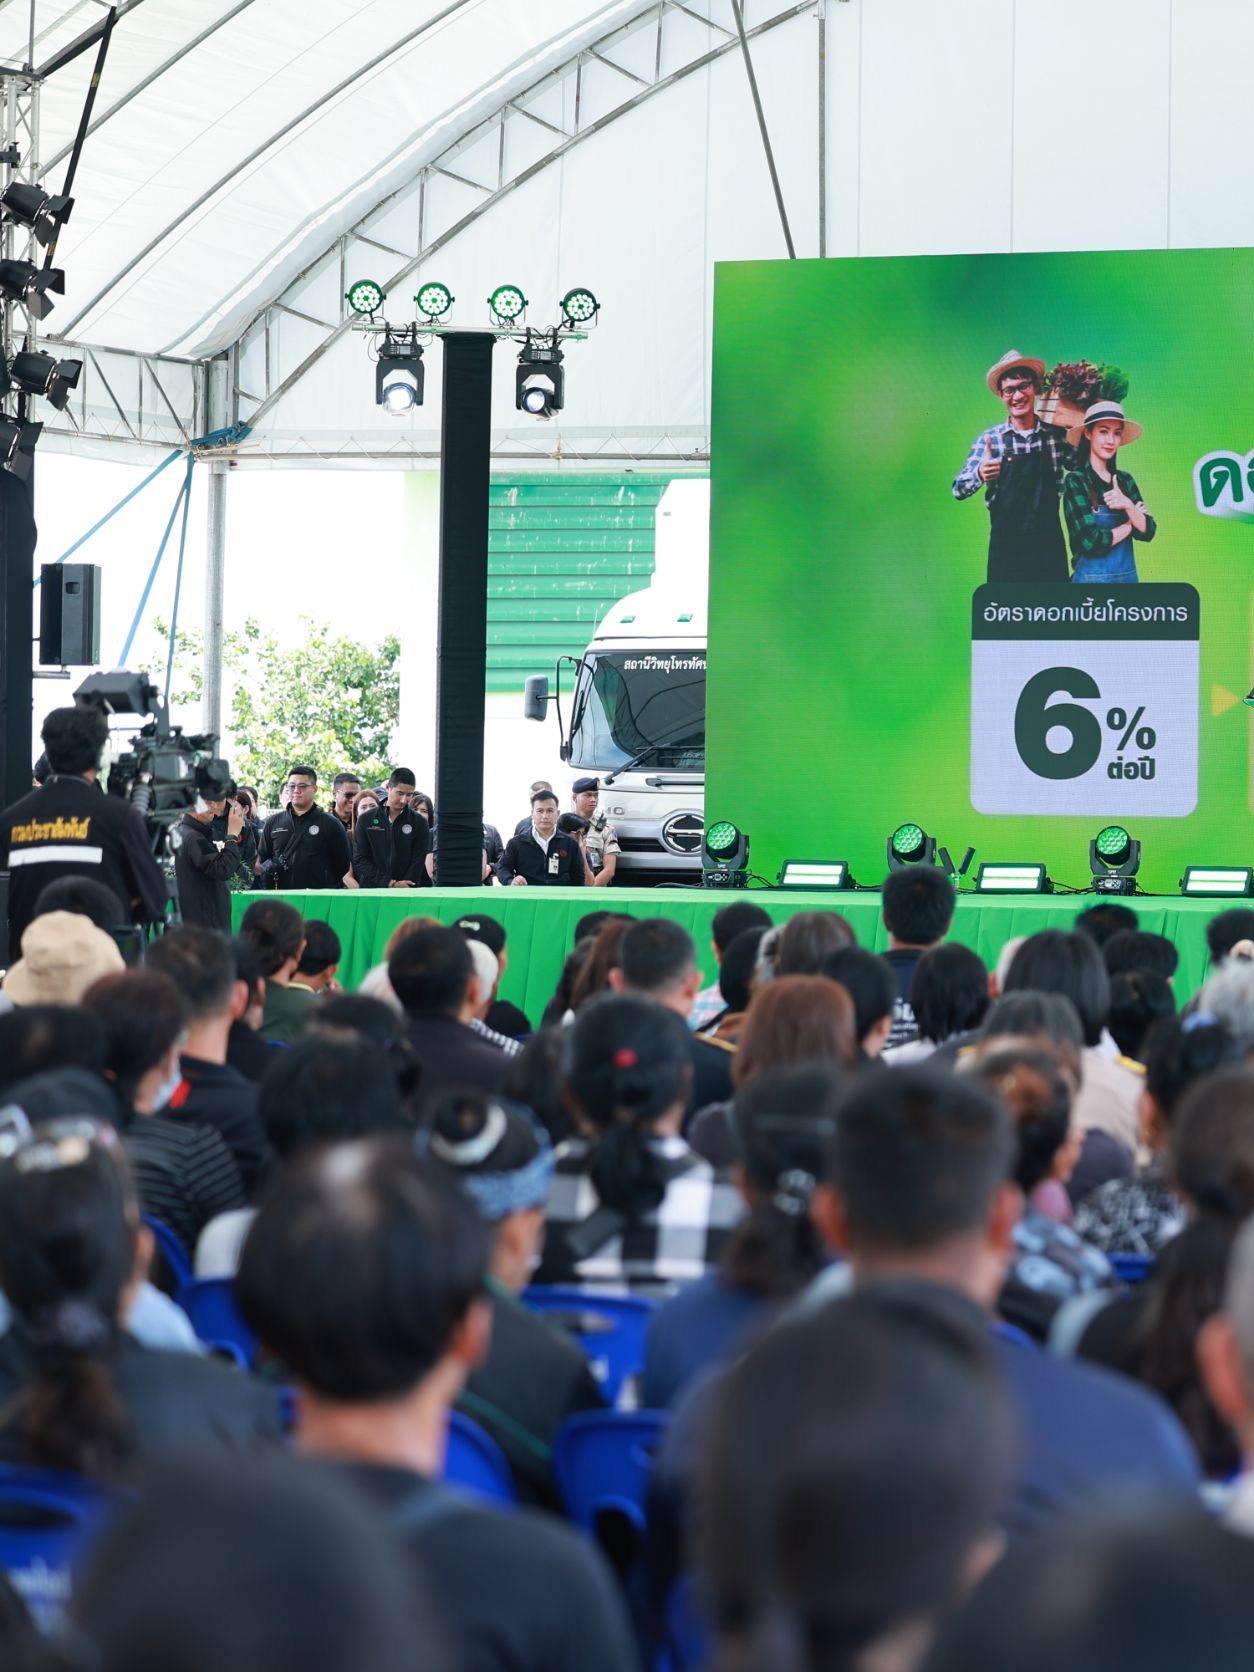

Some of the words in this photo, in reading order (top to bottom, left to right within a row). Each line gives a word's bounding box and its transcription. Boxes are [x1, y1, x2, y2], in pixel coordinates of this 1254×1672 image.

[983, 597, 1188, 622] อัตราดอกเบี้ยโครงการ
[1107, 756, 1156, 781] ต่อปี
